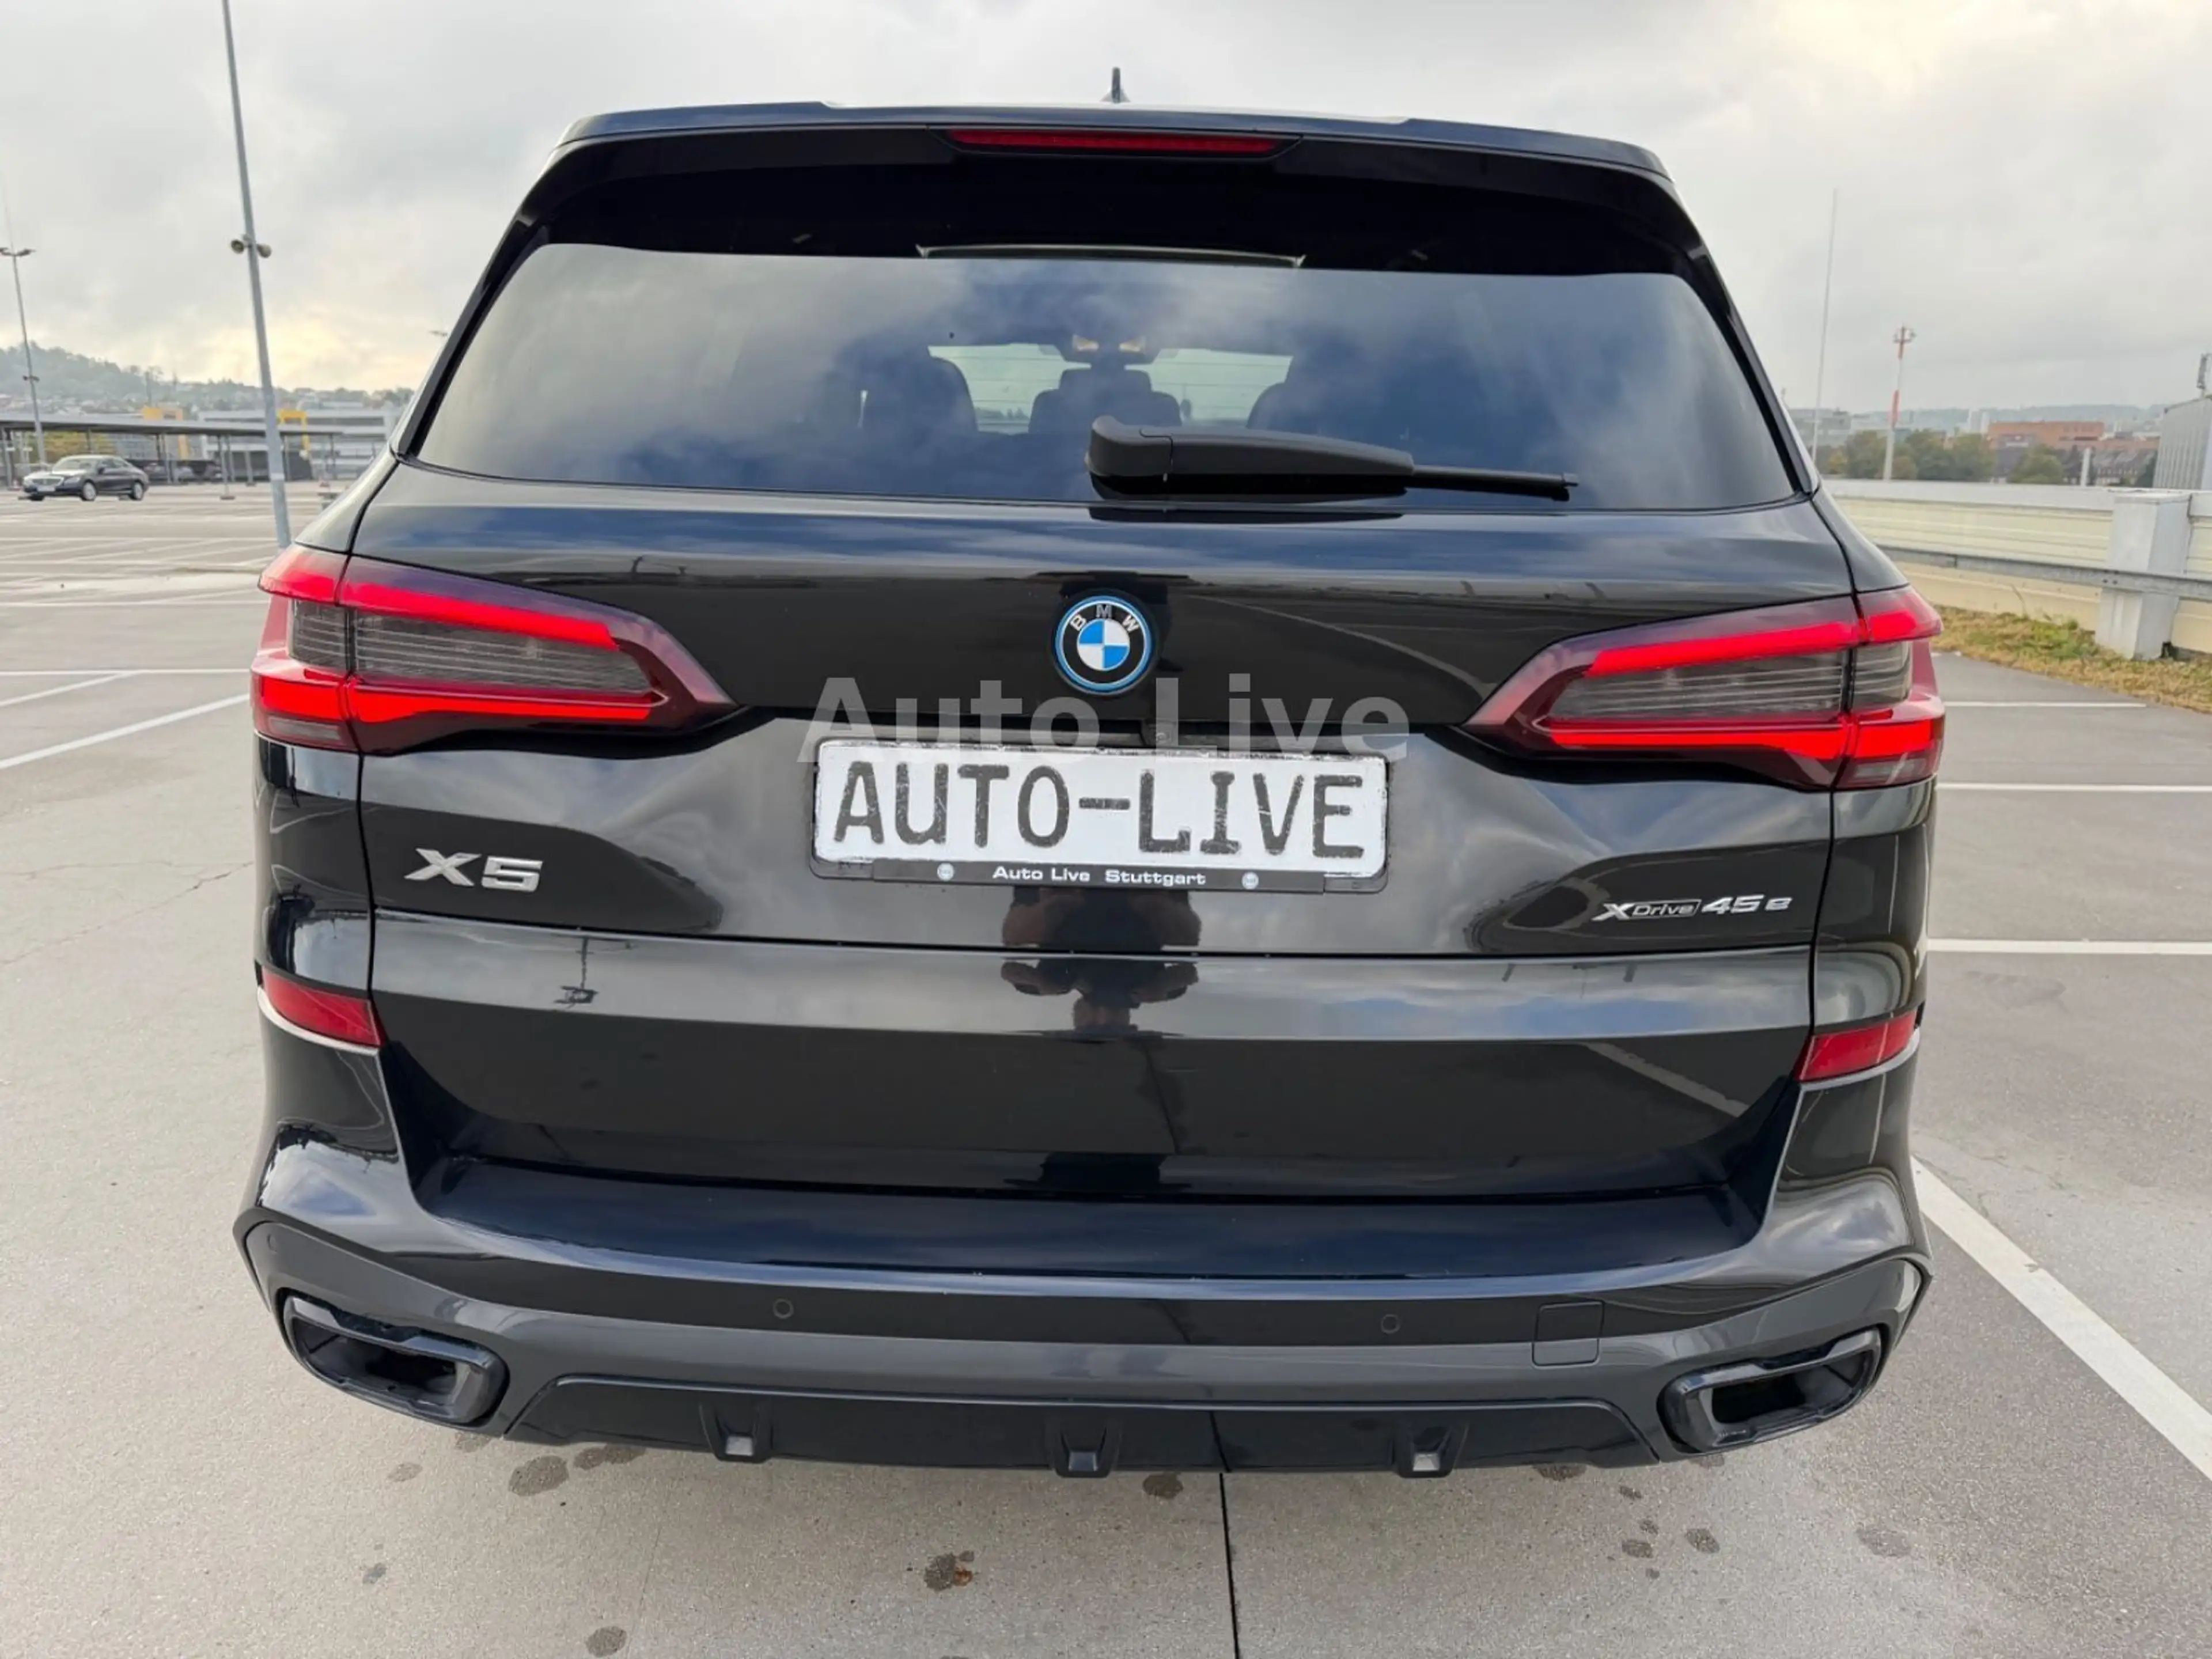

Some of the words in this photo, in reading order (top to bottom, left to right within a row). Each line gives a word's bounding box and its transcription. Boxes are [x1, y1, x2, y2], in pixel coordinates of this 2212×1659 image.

[1069, 604, 1141, 632] BMW
[833, 761, 1365, 858] AUTO-LIVE
[404, 848, 543, 892] X5
[993, 866, 1043, 881] Auto
[1051, 868, 1090, 881] Live
[1105, 869, 1206, 886] Stuttgart
